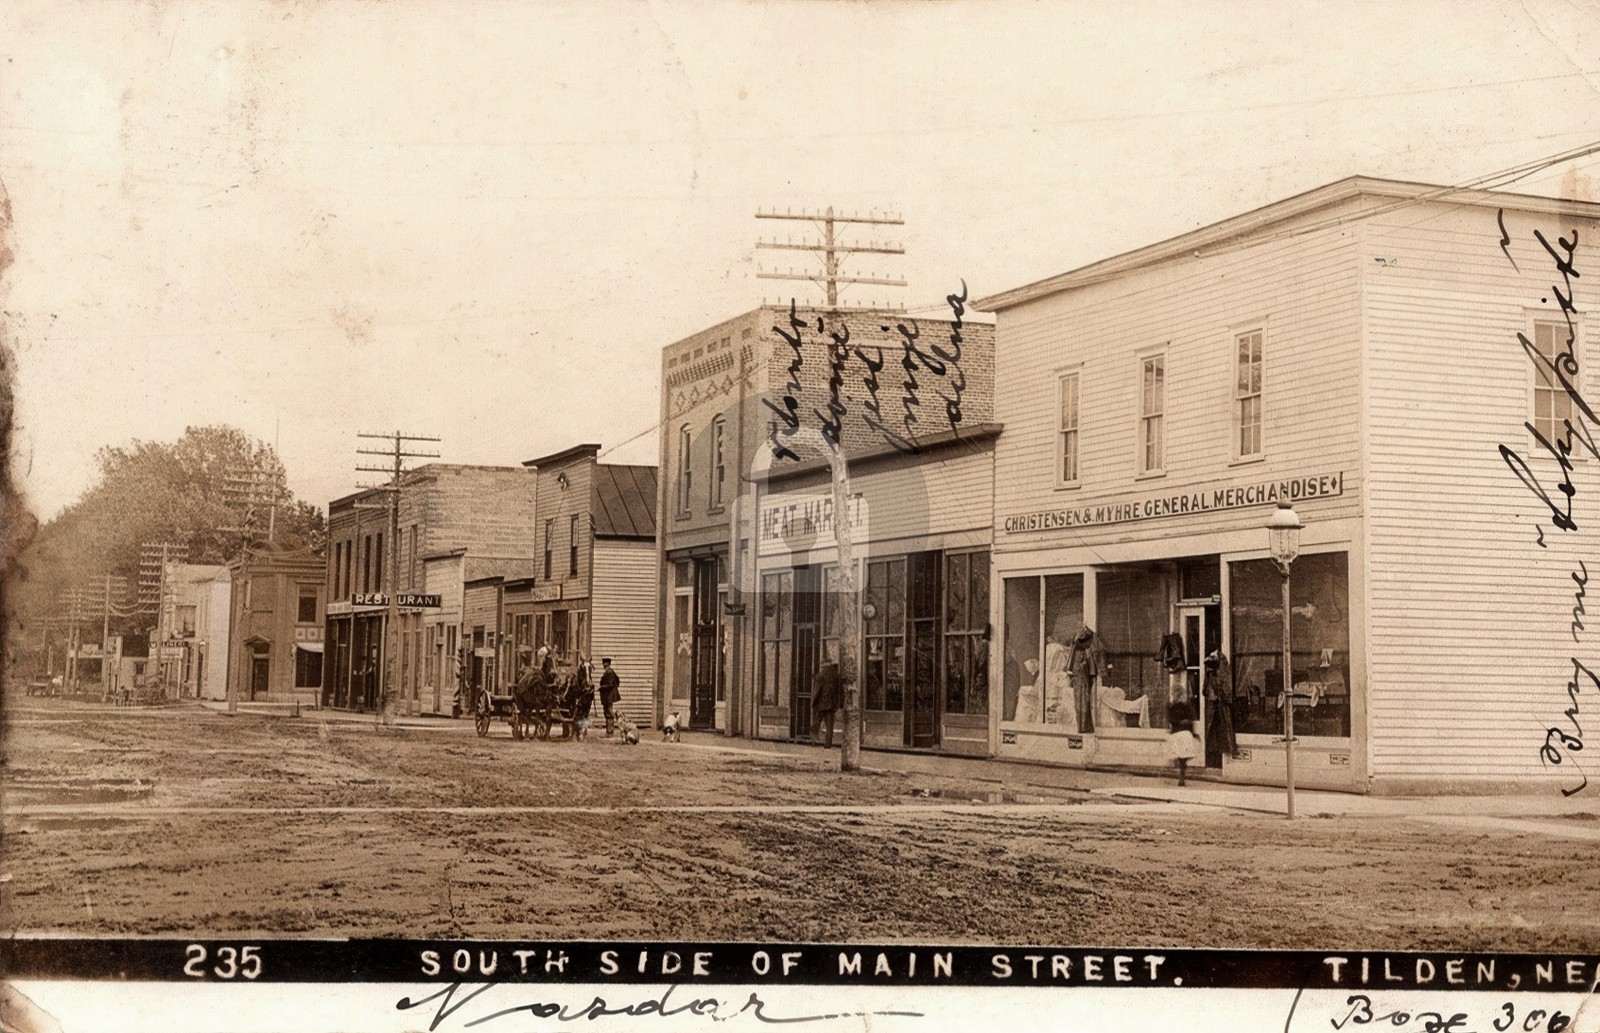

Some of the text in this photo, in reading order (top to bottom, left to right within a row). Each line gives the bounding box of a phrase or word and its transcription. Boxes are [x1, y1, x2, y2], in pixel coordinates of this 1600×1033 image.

[1213, 476, 1329, 508] MERCHANDISE
[763, 504, 797, 540] MEAT
[355, 593, 440, 605] RESTURANT
